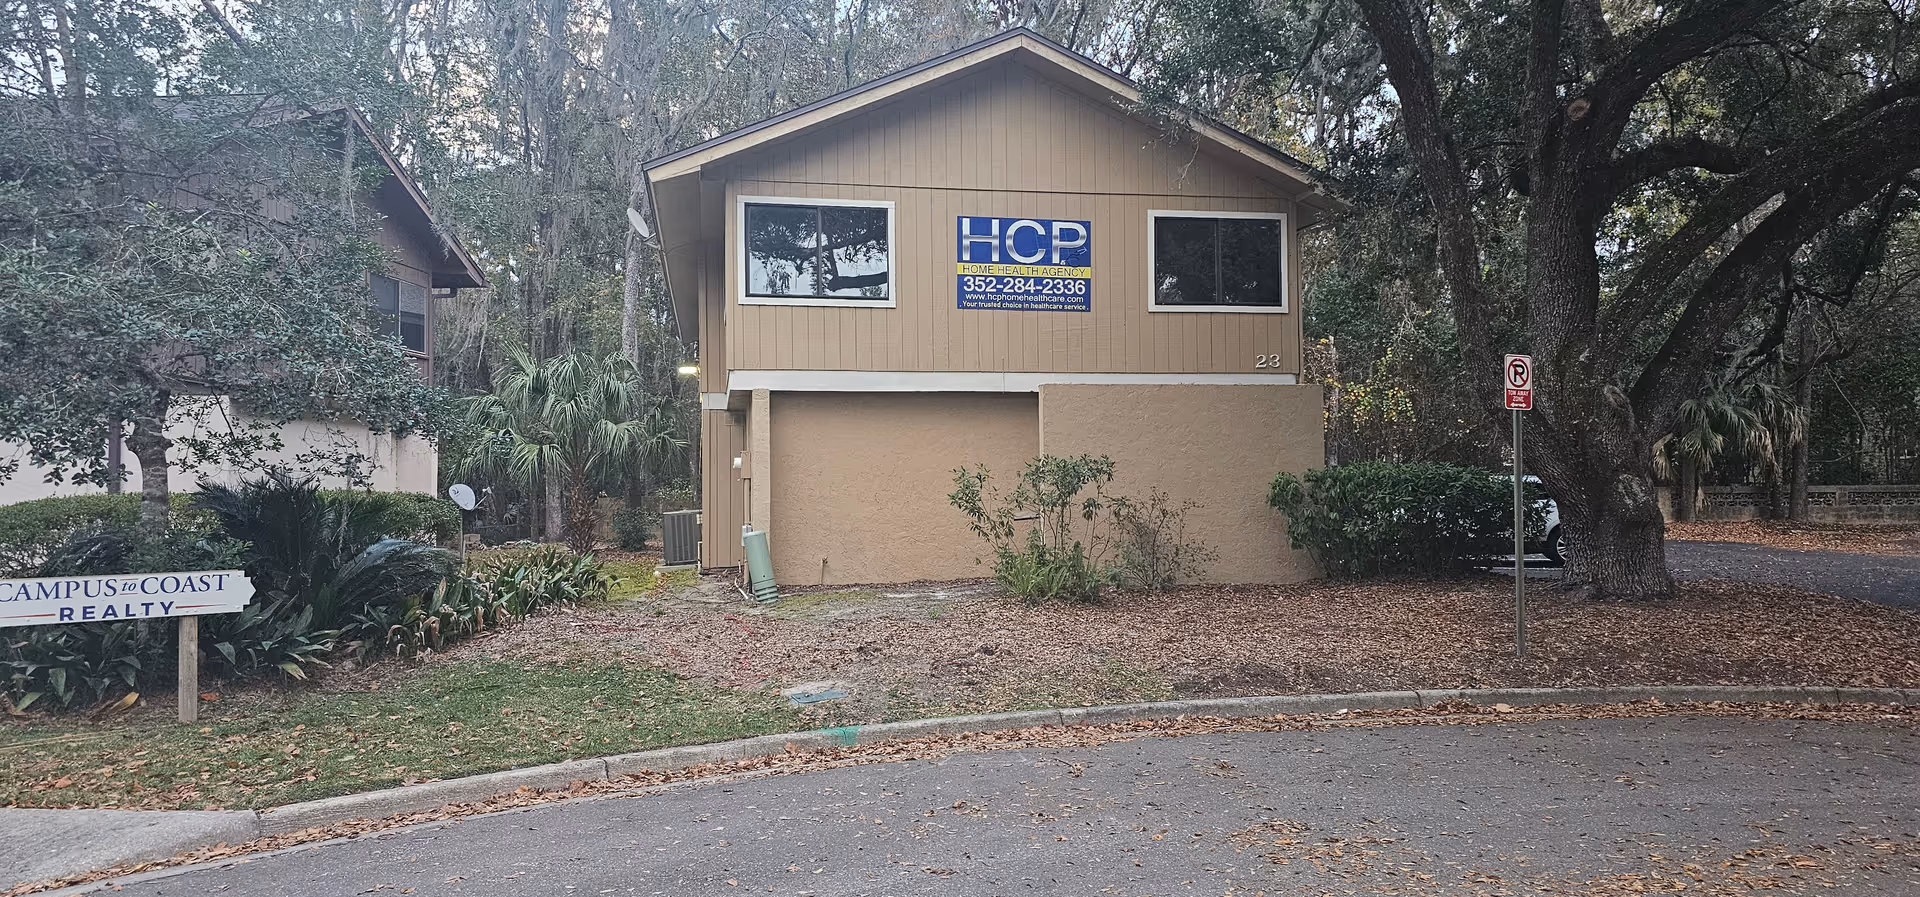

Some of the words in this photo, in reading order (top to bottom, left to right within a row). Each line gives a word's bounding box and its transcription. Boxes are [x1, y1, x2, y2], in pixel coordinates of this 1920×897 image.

[962, 218, 1087, 264] HCP
[962, 264, 994, 274] HOME
[997, 265, 1039, 276] HEALTH
[1041, 267, 1085, 277] AGENCY
[963, 276, 1086, 295] 352-284-2336
[963, 300, 978, 308] Your
[1002, 301, 1023, 309] choice
[1030, 302, 1063, 310] healthcare
[965, 293, 1084, 303] www.hcphomehealthcare.com
[1256, 354, 1280, 368] 23
[0, 578, 117, 603] CAMPUS
[121, 582, 137, 592] to
[140, 573, 230, 595] COAST
[59, 601, 175, 622] REALTY
